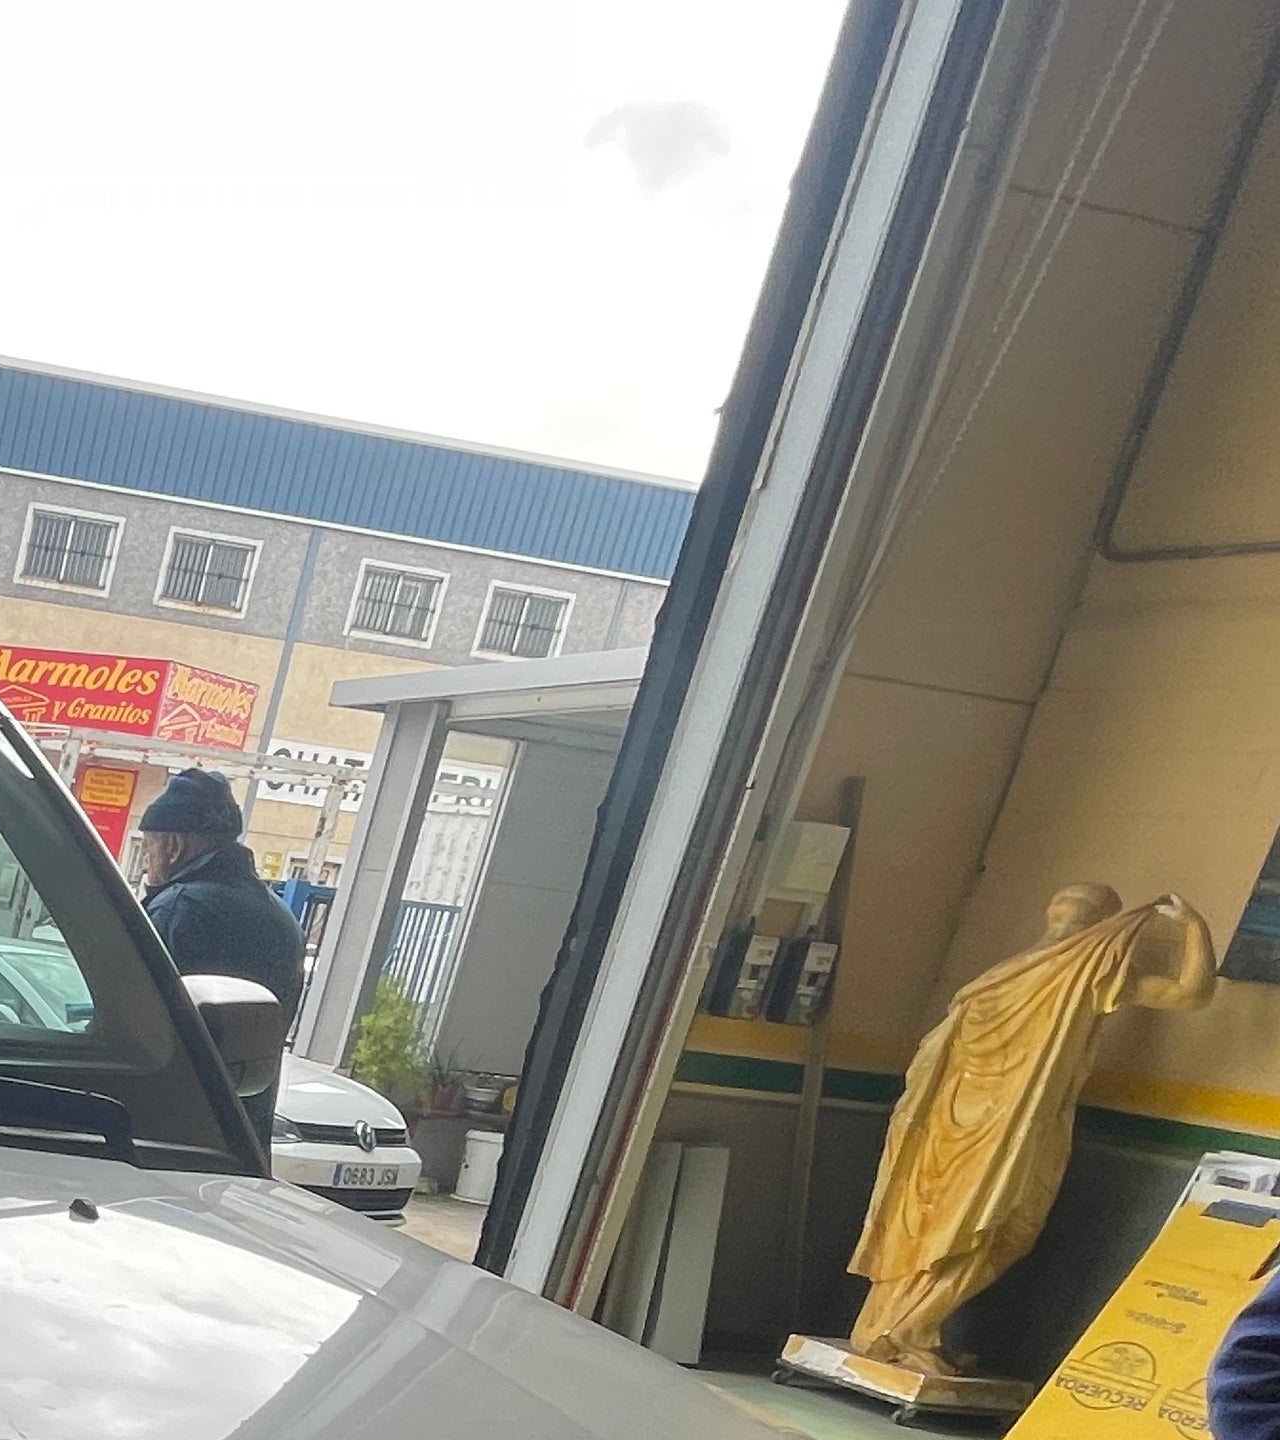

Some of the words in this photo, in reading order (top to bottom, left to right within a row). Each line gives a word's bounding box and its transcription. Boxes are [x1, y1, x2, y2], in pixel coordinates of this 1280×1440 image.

[52, 701, 67, 722] y
[67, 697, 152, 725] Granitos
[1055, 1376, 1148, 1411] RECUERDA
